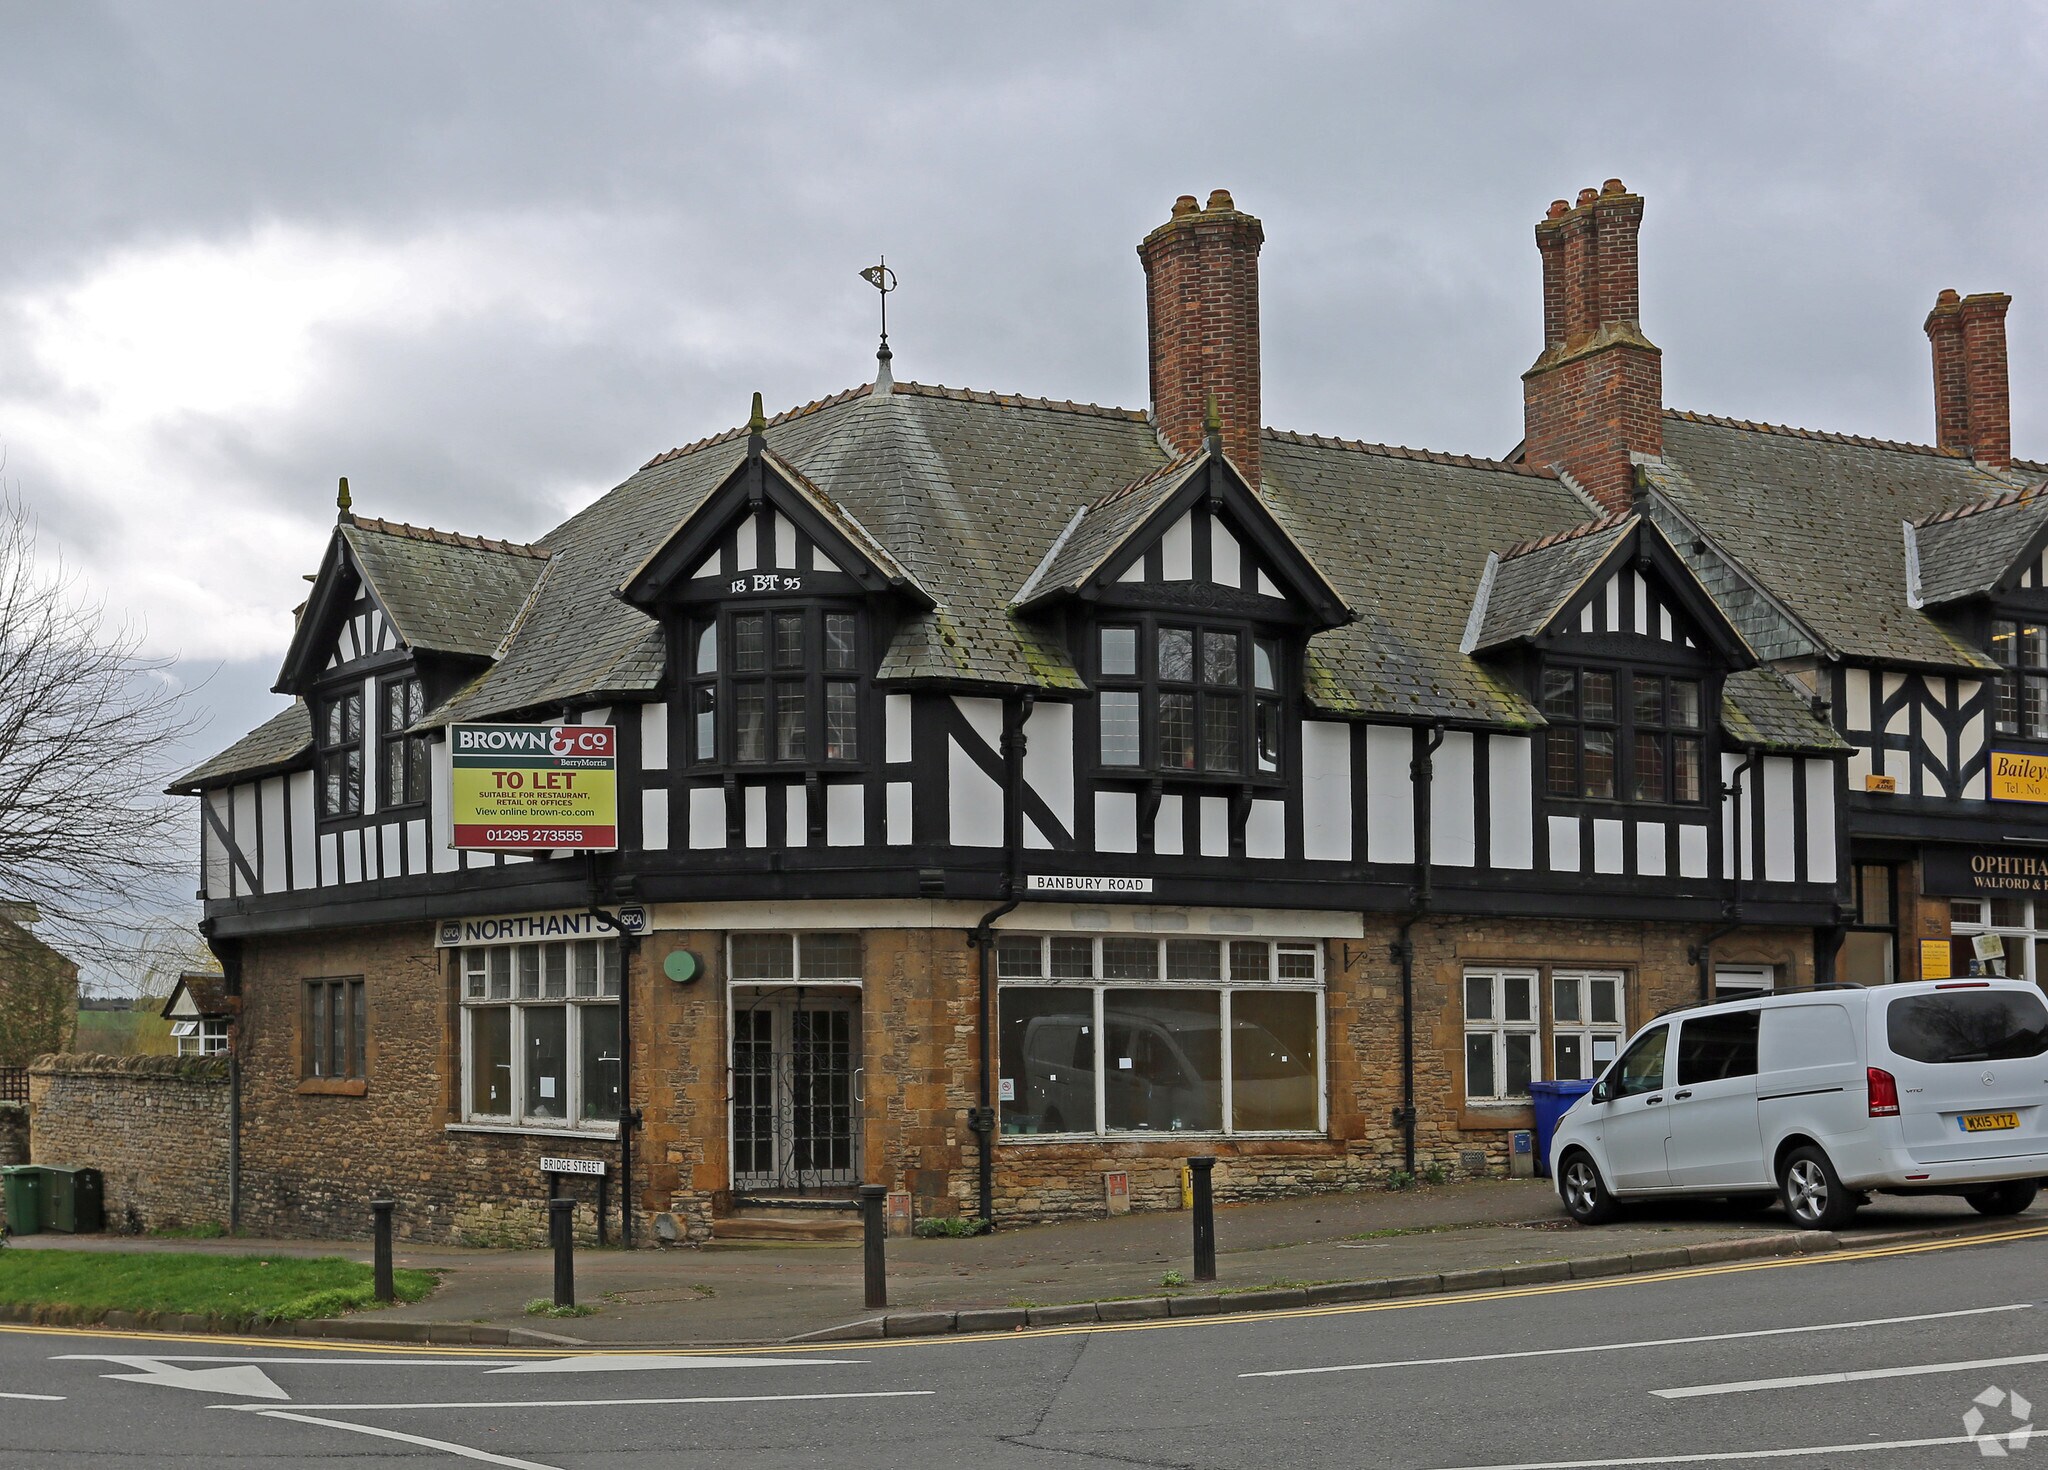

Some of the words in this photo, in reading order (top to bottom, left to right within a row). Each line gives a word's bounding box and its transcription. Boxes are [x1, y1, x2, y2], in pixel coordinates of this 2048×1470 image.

[731, 579, 746, 593] 18
[783, 577, 801, 590] 95
[459, 731, 546, 750] BROWN
[549, 727, 575, 756] &
[560, 758, 607, 767] BerryMorris
[492, 771, 523, 789] TO
[533, 772, 576, 790] LET
[479, 791, 516, 799] SUITABLE
[537, 792, 590, 800] RESTAURANT,
[475, 807, 497, 816] View
[500, 808, 528, 816] online
[530, 808, 595, 816] brown-co.com
[486, 829, 529, 841] 01295
[532, 829, 583, 842] 273555
[1037, 877, 1102, 889] BANBURY
[1108, 879, 1144, 891] ROAD
[1974, 876, 2030, 890] WALFORD
[2032, 879, 2041, 890] &
[621, 914, 643, 926] RSPCA
[1966, 1115, 1992, 1129] WX15
[1992, 1114, 2016, 1127] YTZ
[544, 1158, 571, 1171] BRIDGE
[573, 1160, 601, 1173] STREET
